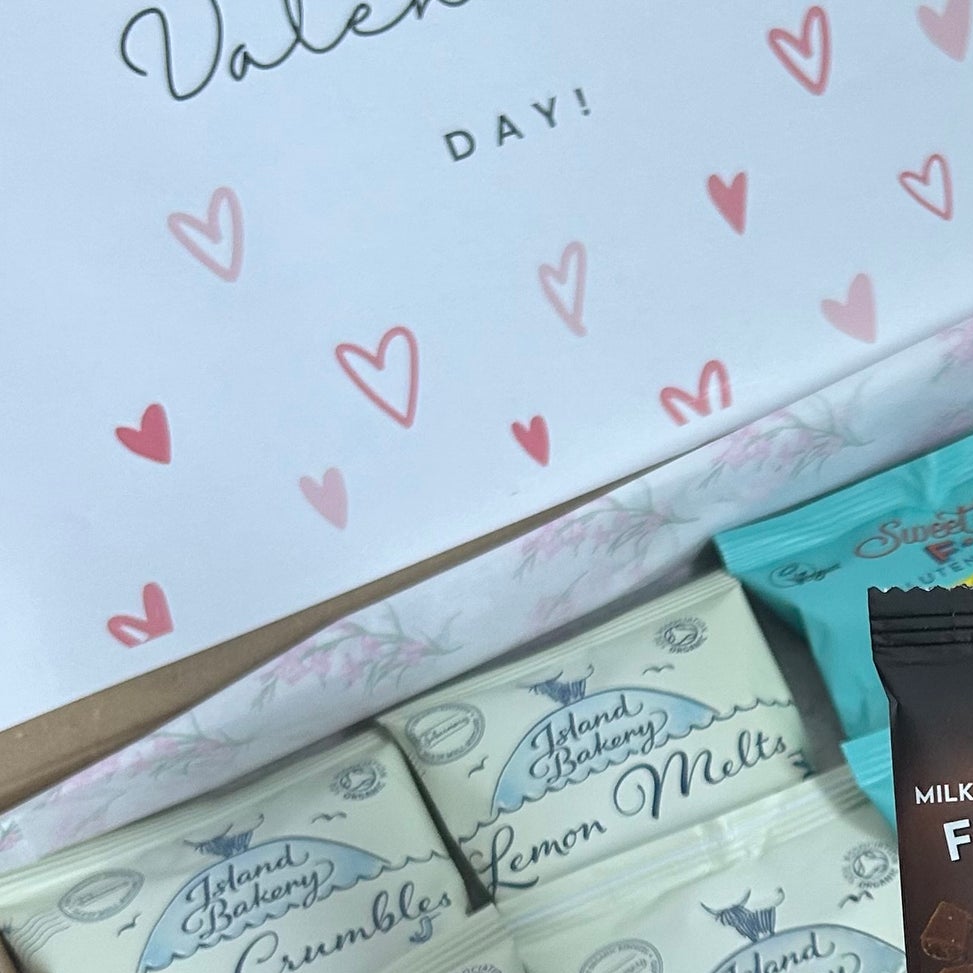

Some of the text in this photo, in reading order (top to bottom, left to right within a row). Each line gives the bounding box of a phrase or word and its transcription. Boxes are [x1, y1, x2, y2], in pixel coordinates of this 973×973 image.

[443, 88, 592, 162] DAY!
[529, 709, 669, 782] Bakery
[530, 695, 643, 757] Island
[613, 730, 788, 820] Melts
[185, 844, 310, 906] Island
[470, 820, 608, 900] Lemon
[181, 859, 335, 936] Bakery
